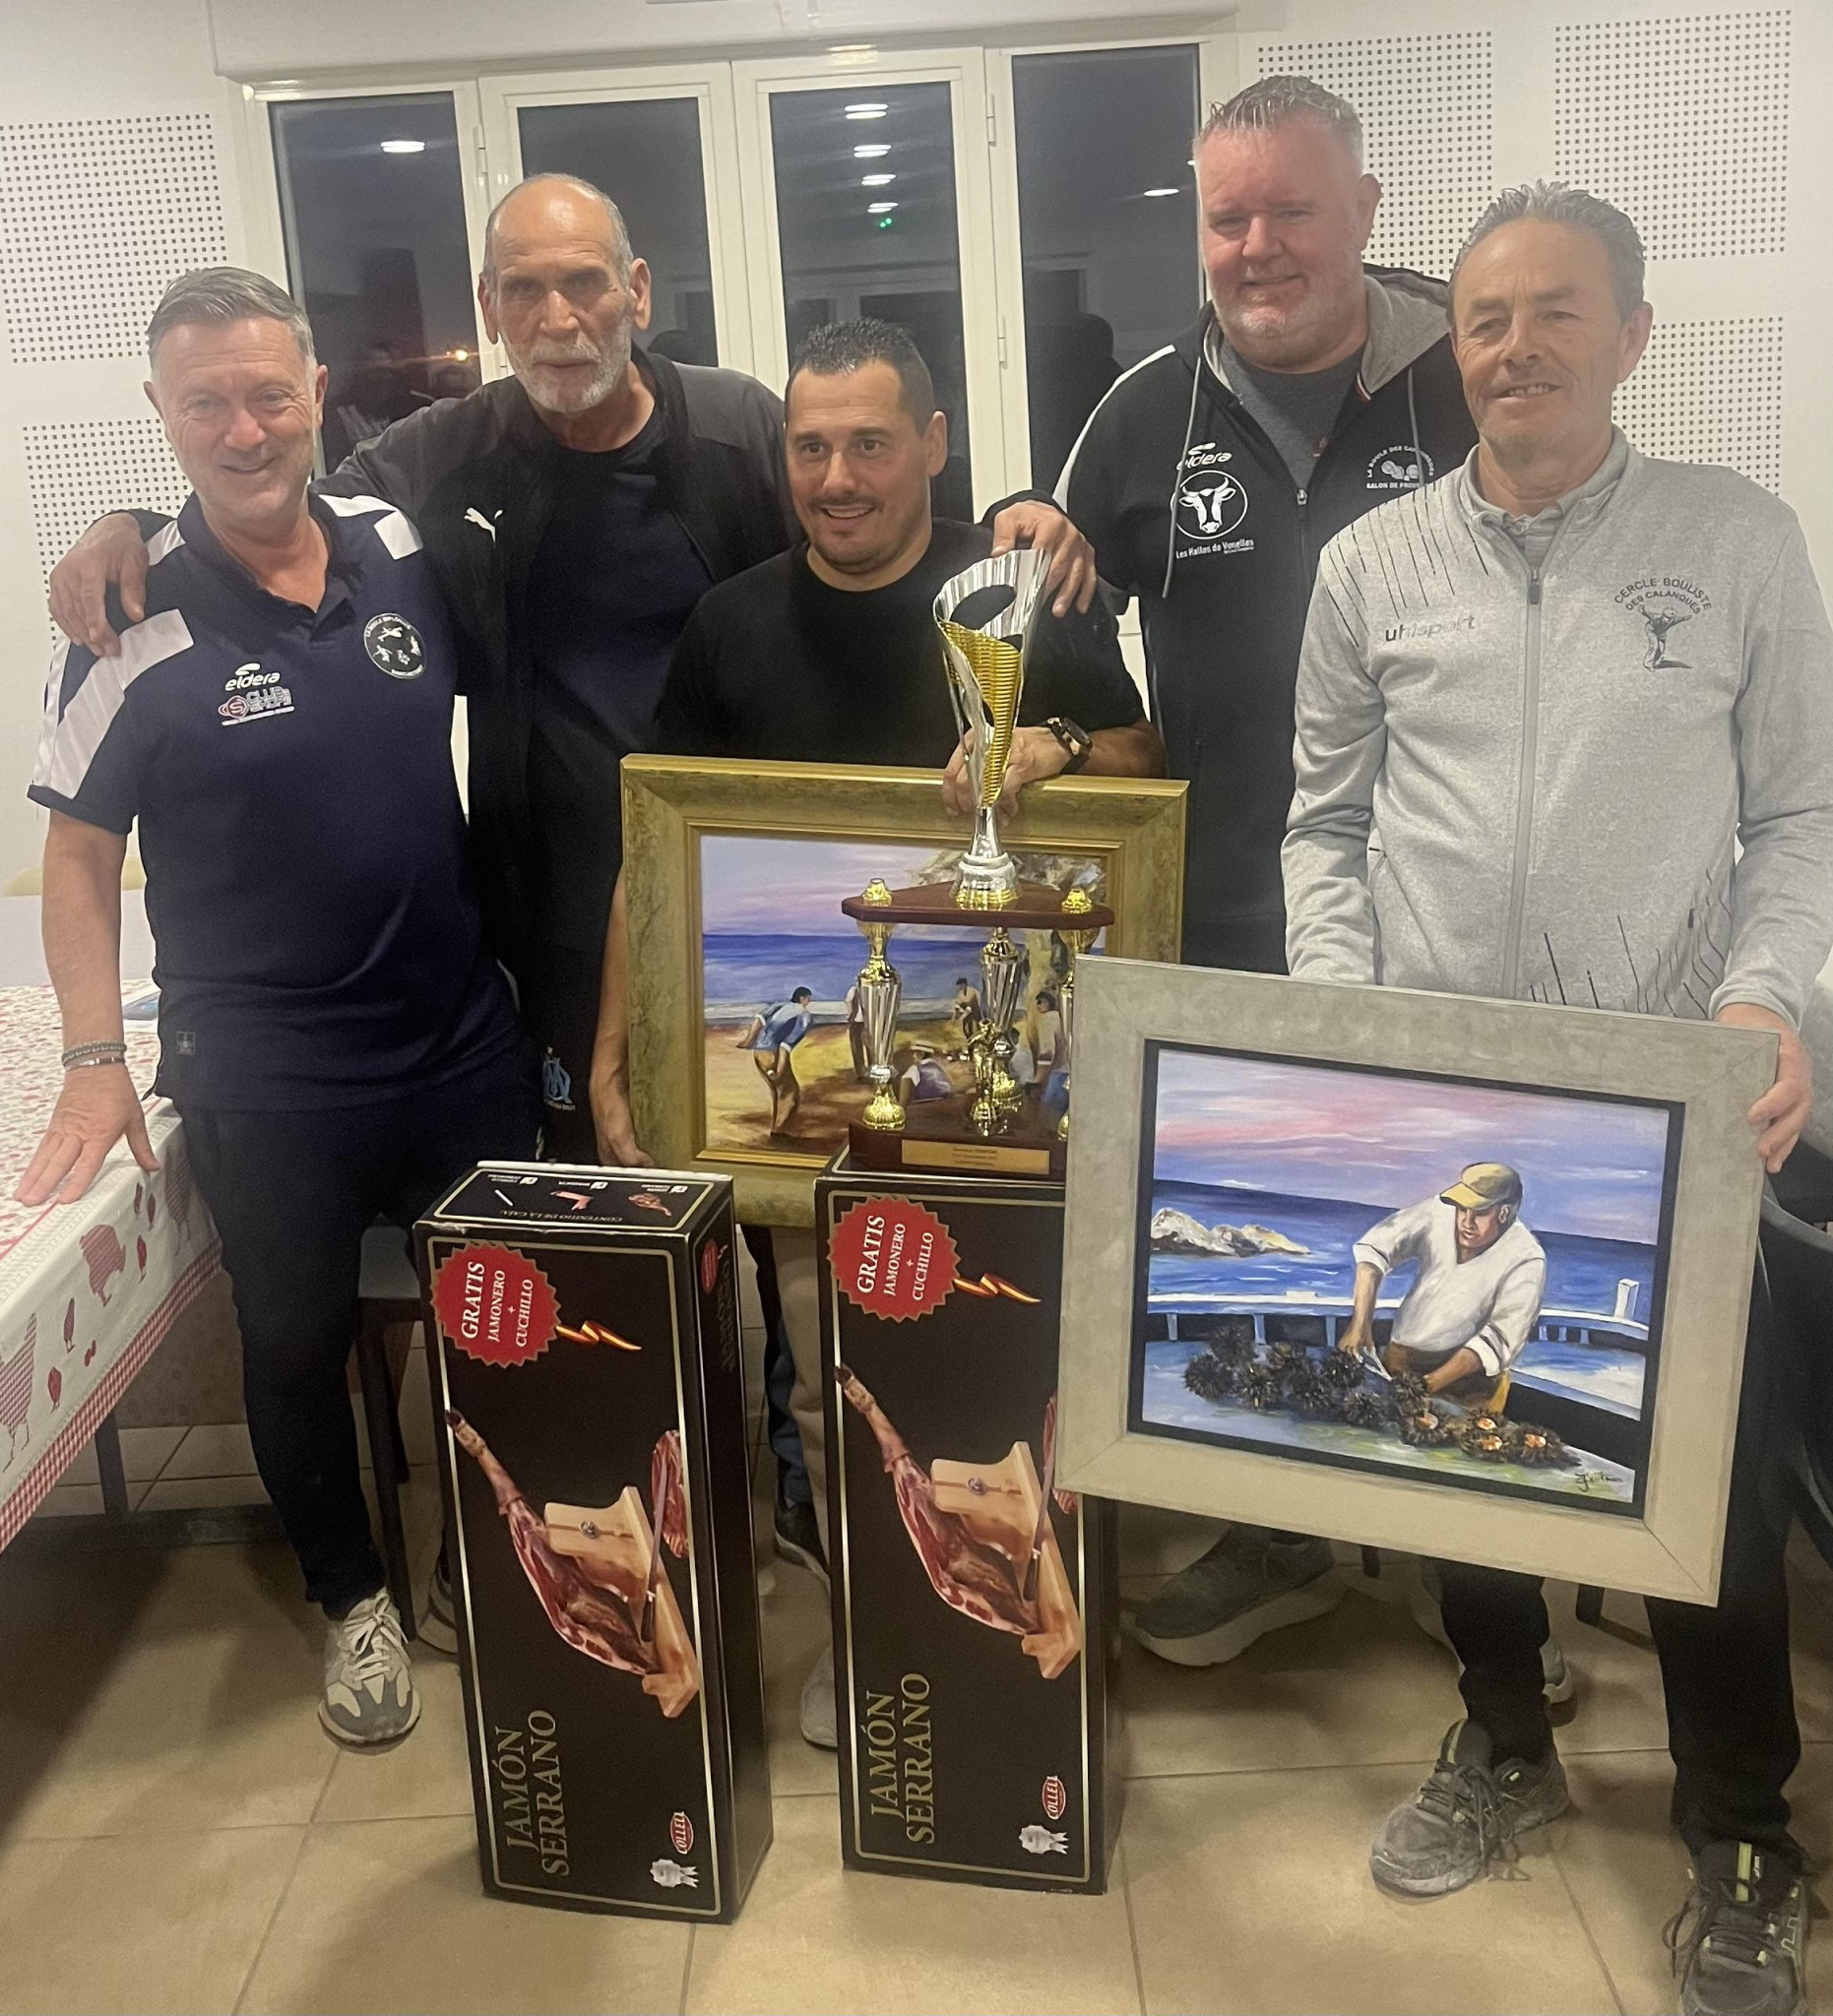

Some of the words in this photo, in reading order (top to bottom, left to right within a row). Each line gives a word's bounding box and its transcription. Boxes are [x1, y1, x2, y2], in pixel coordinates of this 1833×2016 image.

[1176, 452, 1232, 471] eldera
[1366, 468, 1373, 478] LA
[1175, 550, 1188, 559] Les
[1188, 545, 1212, 557] Halles
[1212, 543, 1222, 552] de
[1385, 613, 1476, 642] uhlsport
[1614, 577, 1658, 603] CERCLE
[1664, 577, 1712, 611] BOULISTE
[1625, 595, 1645, 611] DES
[1645, 591, 1702, 614] CALANQUES
[224, 671, 281, 691] eldera
[246, 686, 284, 703] CLUB
[856, 1215, 886, 1293] GRATIS
[883, 1223, 906, 1297] JAMONERO
[912, 1231, 934, 1301] CUCHILLO
[461, 1261, 485, 1340] GRATIS
[488, 1270, 506, 1342] JAMONERO
[515, 1279, 534, 1348] CUCHILLO
[492, 1726, 540, 1853] JAMÓN
[860, 1690, 905, 1821] JAMÓN
[901, 1672, 935, 1845] SERRANO
[528, 1710, 570, 1877] SERRANO
